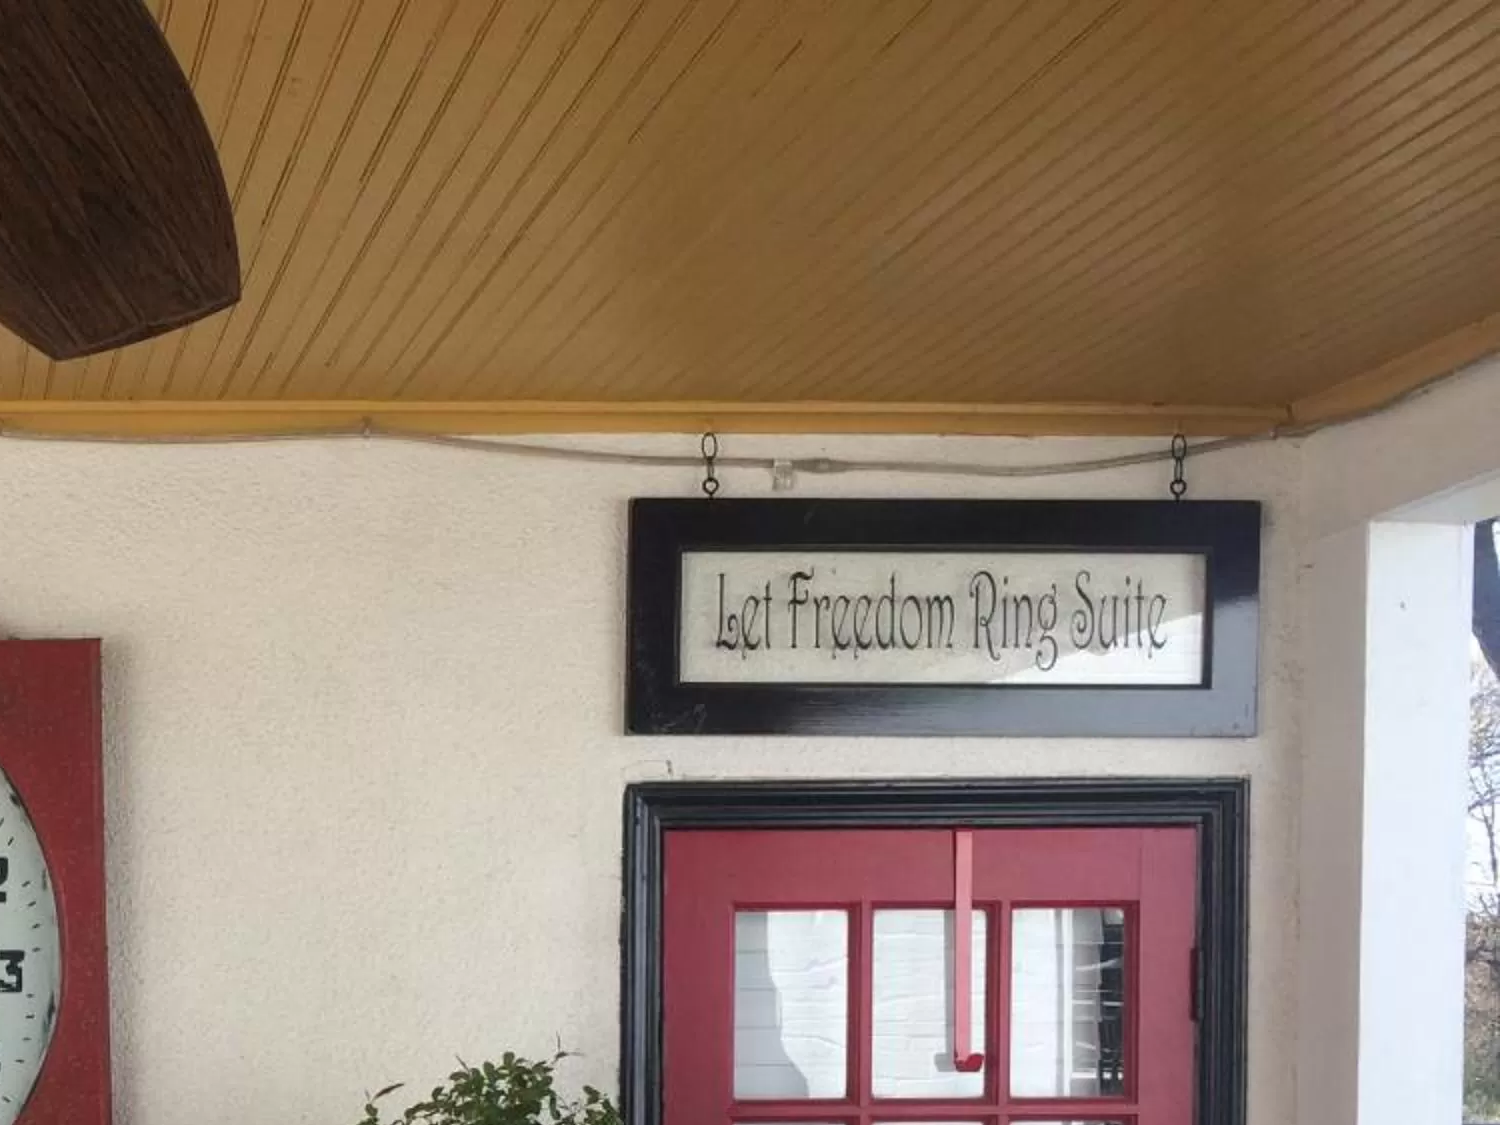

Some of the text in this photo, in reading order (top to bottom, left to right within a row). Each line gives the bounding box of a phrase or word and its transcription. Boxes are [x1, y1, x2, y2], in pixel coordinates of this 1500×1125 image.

[714, 567, 1169, 672] Let Freedom Ring Suite
